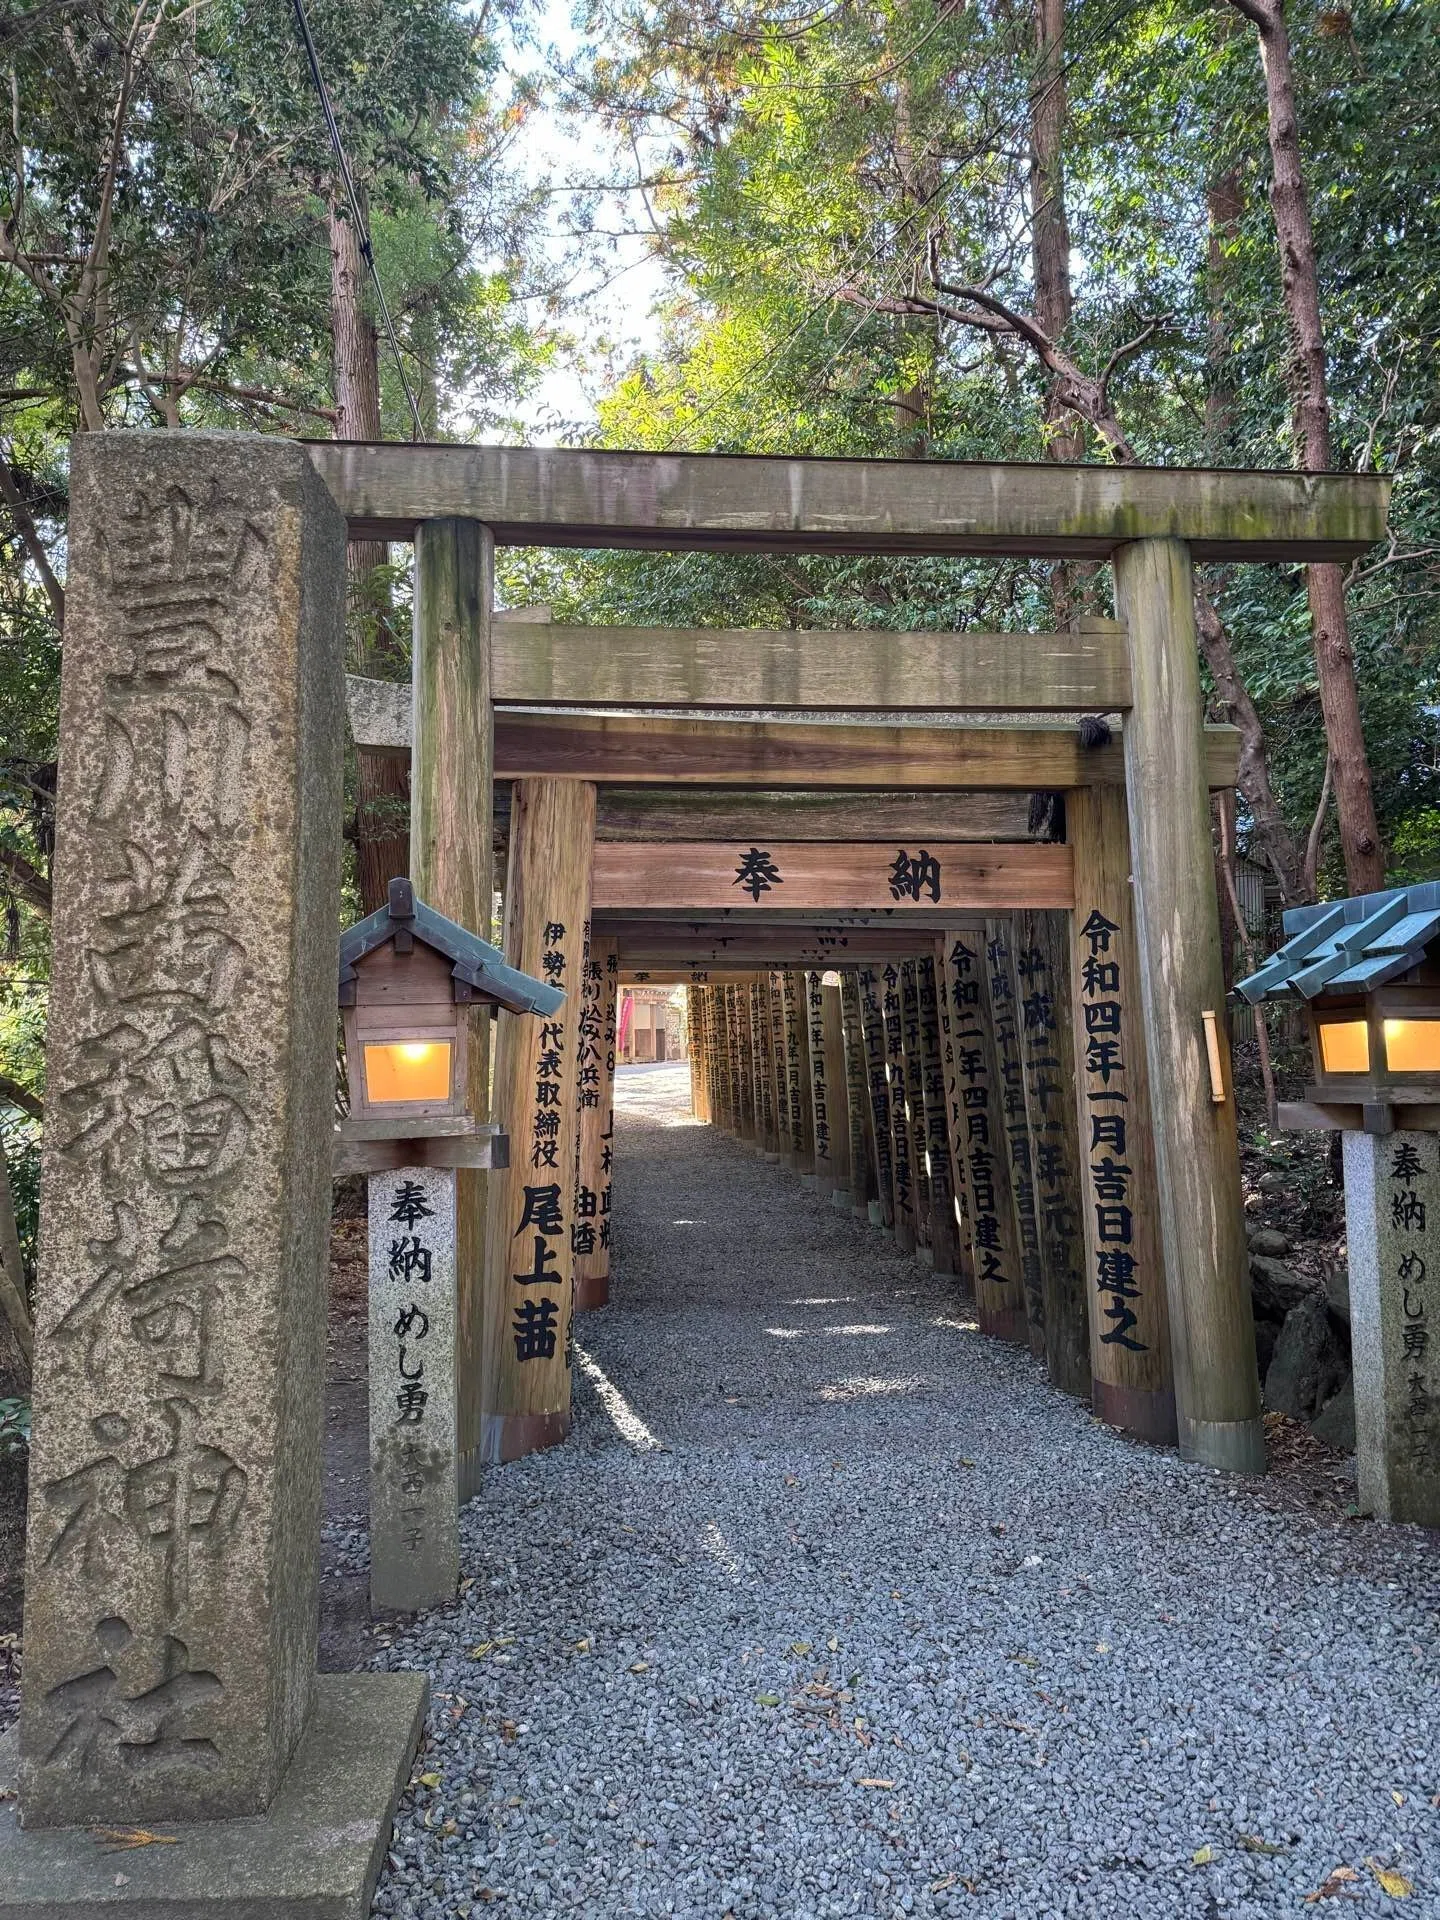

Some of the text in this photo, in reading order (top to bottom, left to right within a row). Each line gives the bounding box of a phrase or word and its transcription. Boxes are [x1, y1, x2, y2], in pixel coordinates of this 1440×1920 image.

[732, 847, 942, 903] 奉納
[531, 1022, 564, 1168] 代表取締役
[808, 971, 832, 1161] 令和二年一月吉日建之
[949, 940, 1009, 1283] 令和二年四月吉日建之
[1080, 909, 1149, 1351] 令和四年一月吉日建之
[387, 1180, 436, 1283] 奉納
[1391, 1142, 1427, 1233] 奉納
